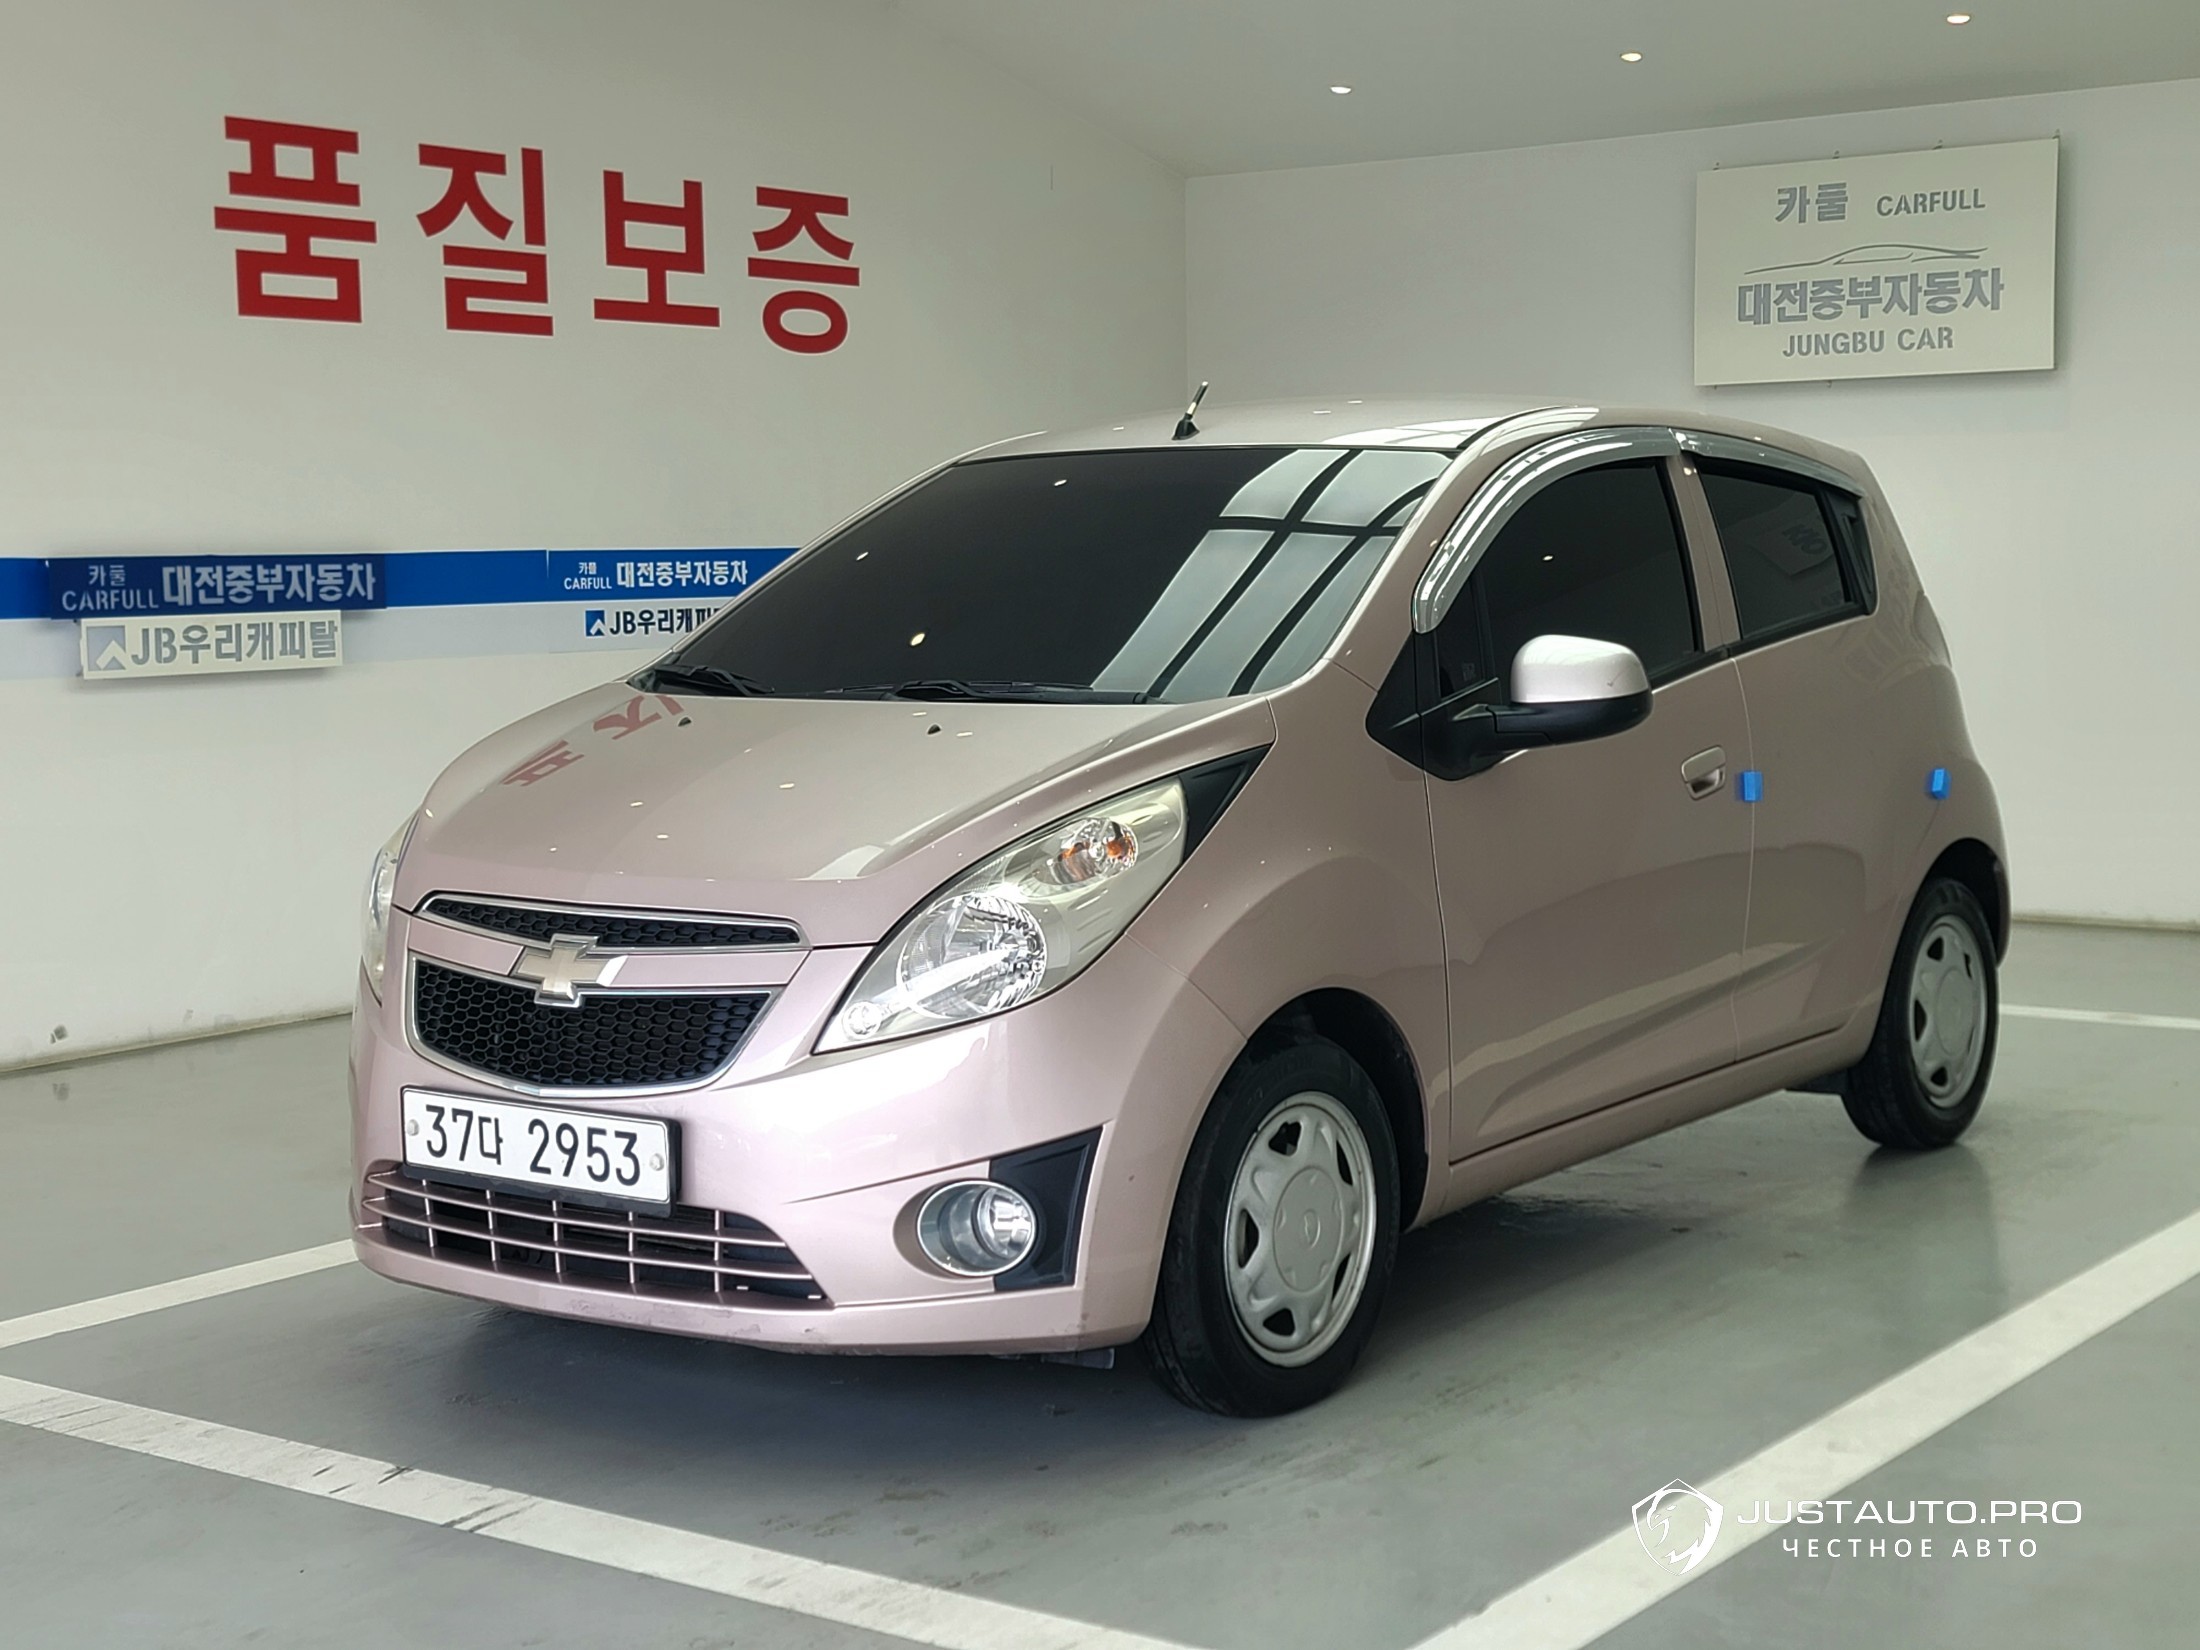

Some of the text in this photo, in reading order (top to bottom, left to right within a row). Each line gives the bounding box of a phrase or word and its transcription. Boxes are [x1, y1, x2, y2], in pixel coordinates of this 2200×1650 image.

[1876, 188, 1986, 217] CARFULL
[213, 115, 861, 355] 품질보증
[1737, 267, 2005, 326] 대전중부자동차
[1782, 326, 1954, 358] JUNGBU CAR
[162, 562, 376, 607] 대전중부자동차
[563, 577, 612, 590] CARFULL
[616, 560, 749, 589] 대전중부자동차
[61, 588, 159, 612] CARFULL
[131, 620, 338, 666] JB우리캐피탈
[425, 1103, 641, 1187] 37다 2953
